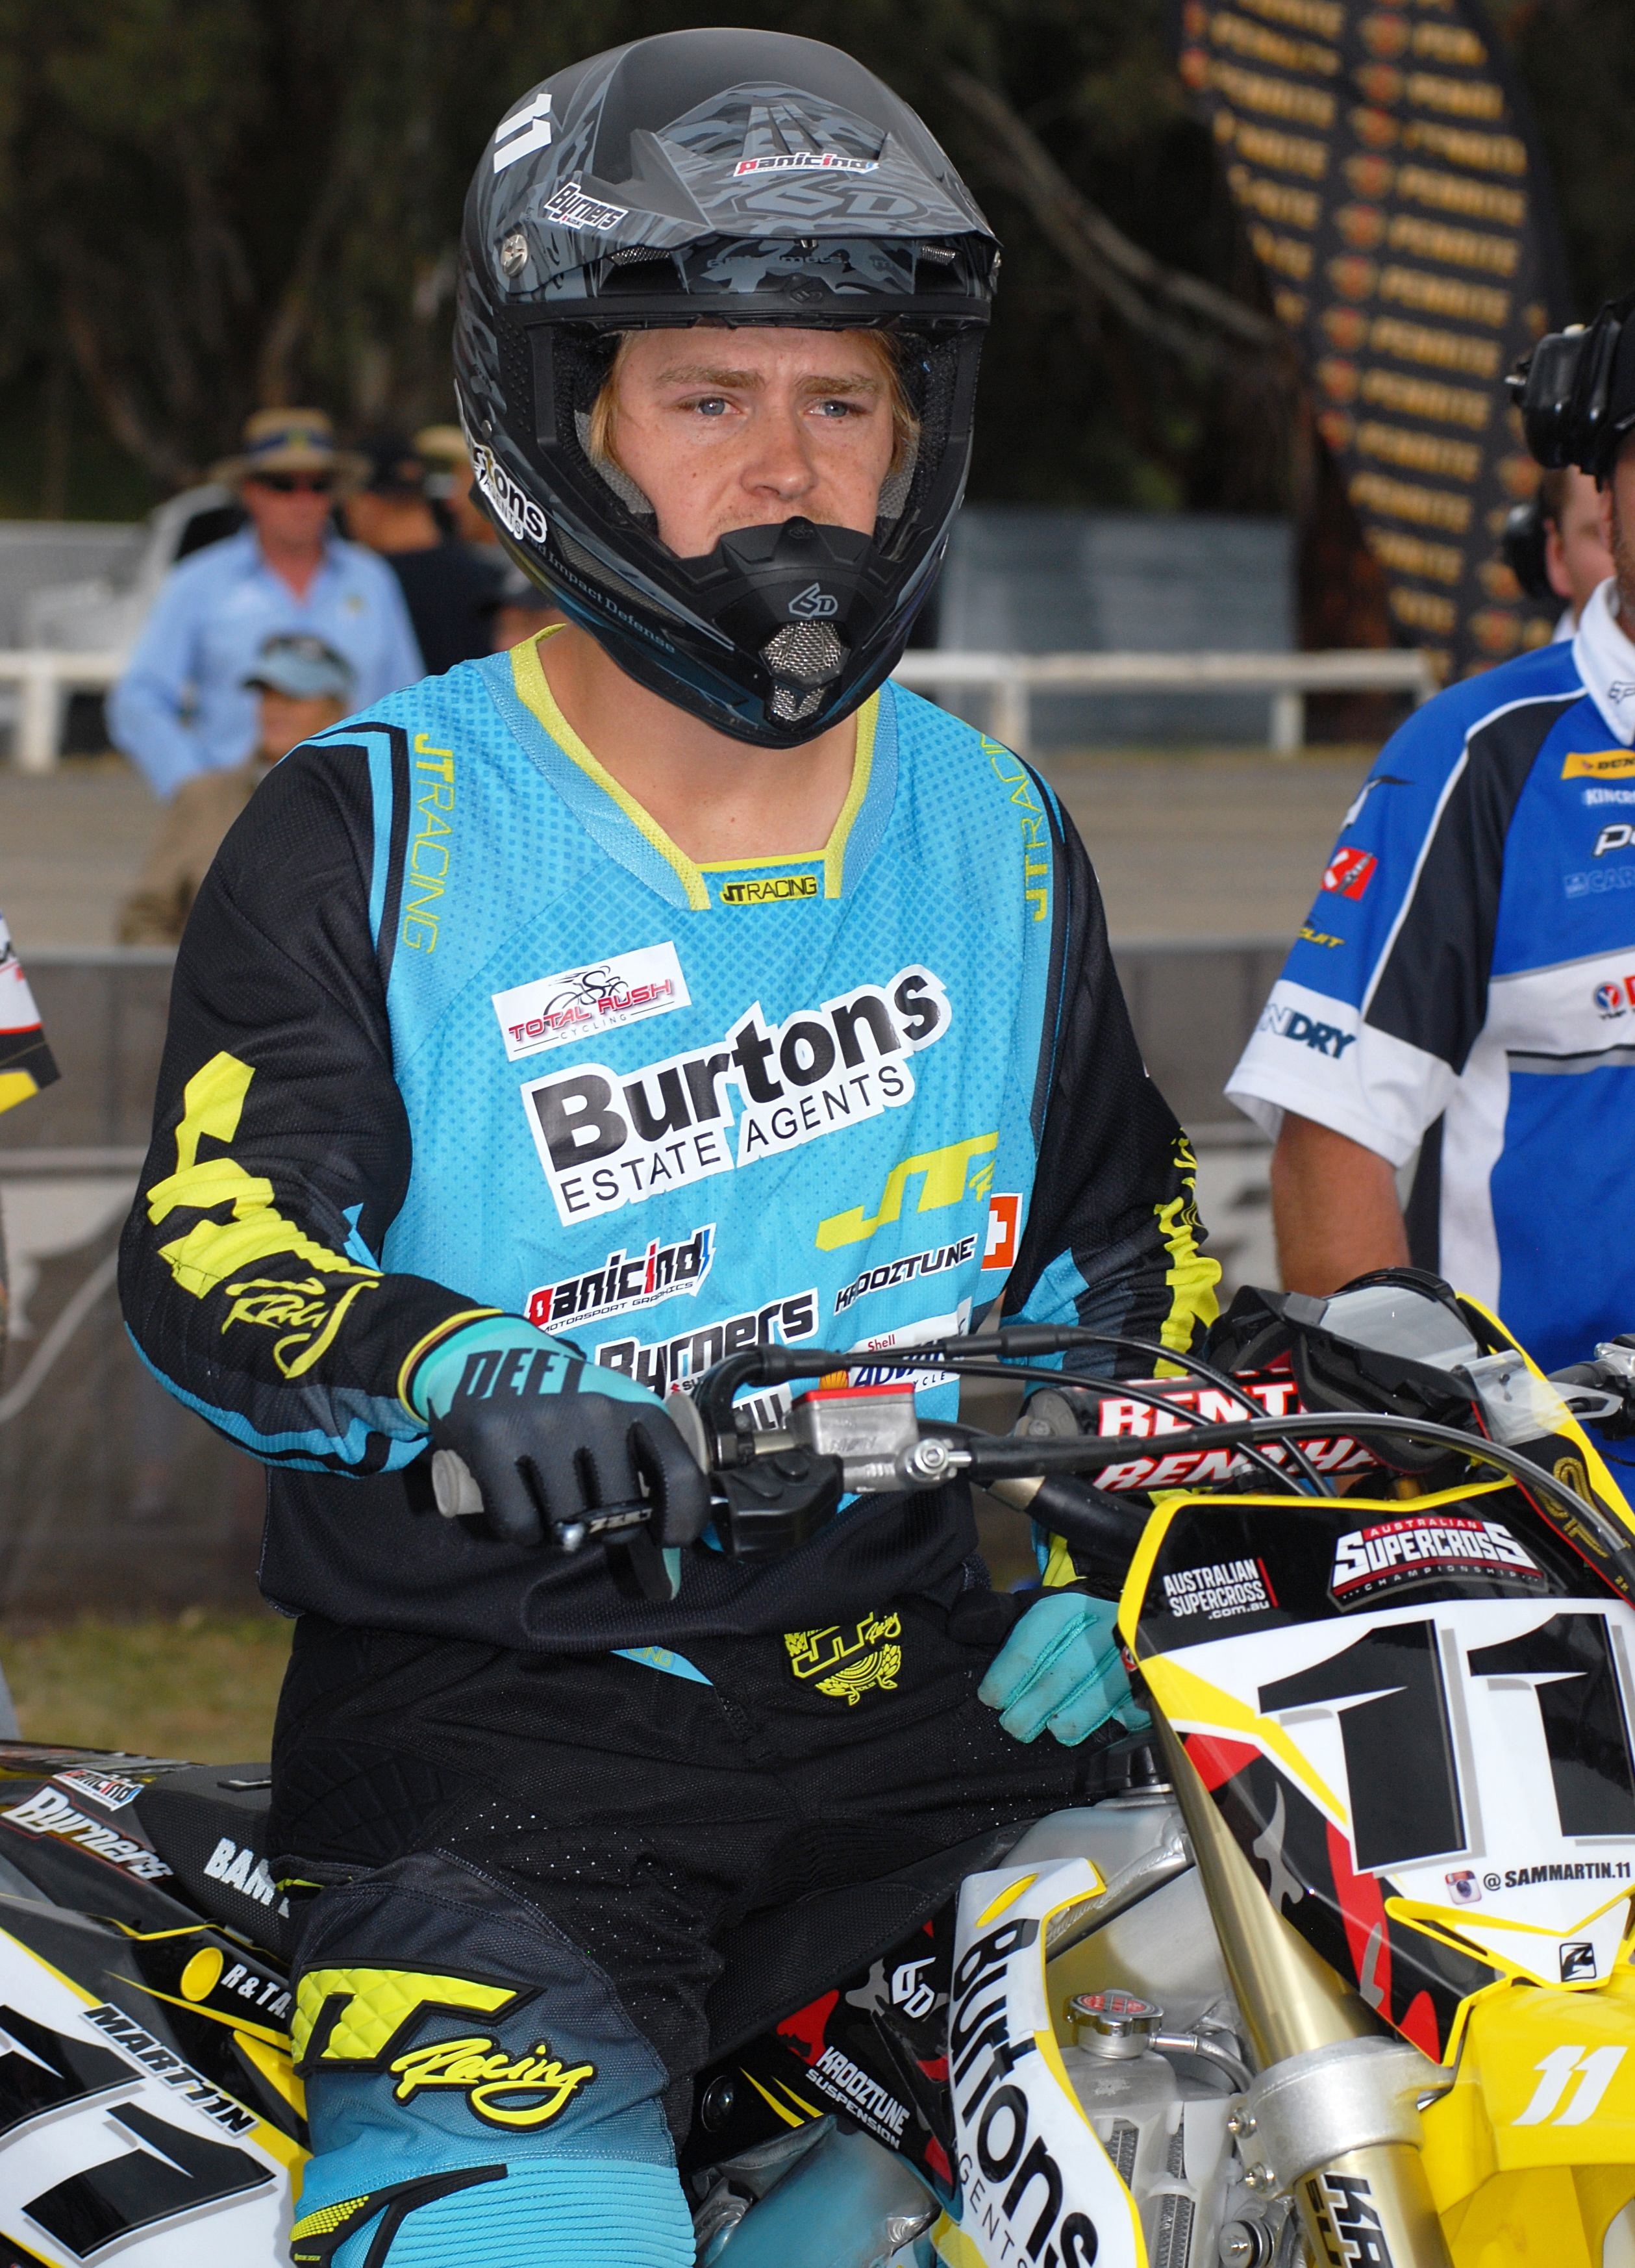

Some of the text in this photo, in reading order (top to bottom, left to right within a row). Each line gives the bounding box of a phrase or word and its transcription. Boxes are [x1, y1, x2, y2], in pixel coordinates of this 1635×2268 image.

[547, 184, 625, 228] Byrners
[547, 553, 603, 602] Impact
[605, 594, 676, 654] Defense
[788, 583, 838, 619] 6D
[508, 979, 673, 1041] TOTAL RUSH
[560, 1013, 628, 1040] CYCLING
[532, 974, 940, 1171] Burtons
[560, 1065, 905, 1213] ESTATE AGENTS
[632, 1281, 695, 1306] GRAPHICS
[867, 1334, 896, 1352] Shell
[1099, 1381, 1307, 1438] RENT
[1332, 1521, 1538, 1588] SUPERCROSS
[1370, 1518, 1477, 1537] AUSTRALIAN
[1163, 1559, 1259, 1597] AUSTRALIAN
[1169, 1580, 1266, 1618] SUPERCROSS
[1208, 1600, 1270, 1620] .com.au
[1258, 1613, 1635, 1871] 11
[1, 1786, 174, 1879] Byrners
[1505, 1861, 1631, 1888] SAMMARTIN.11
[390, 2038, 593, 2126] Racing
[805, 2068, 900, 2150] SUSPENSION
[816, 2046, 910, 2136] KROOZTUNE
[1512, 2045, 1628, 2125] 11
